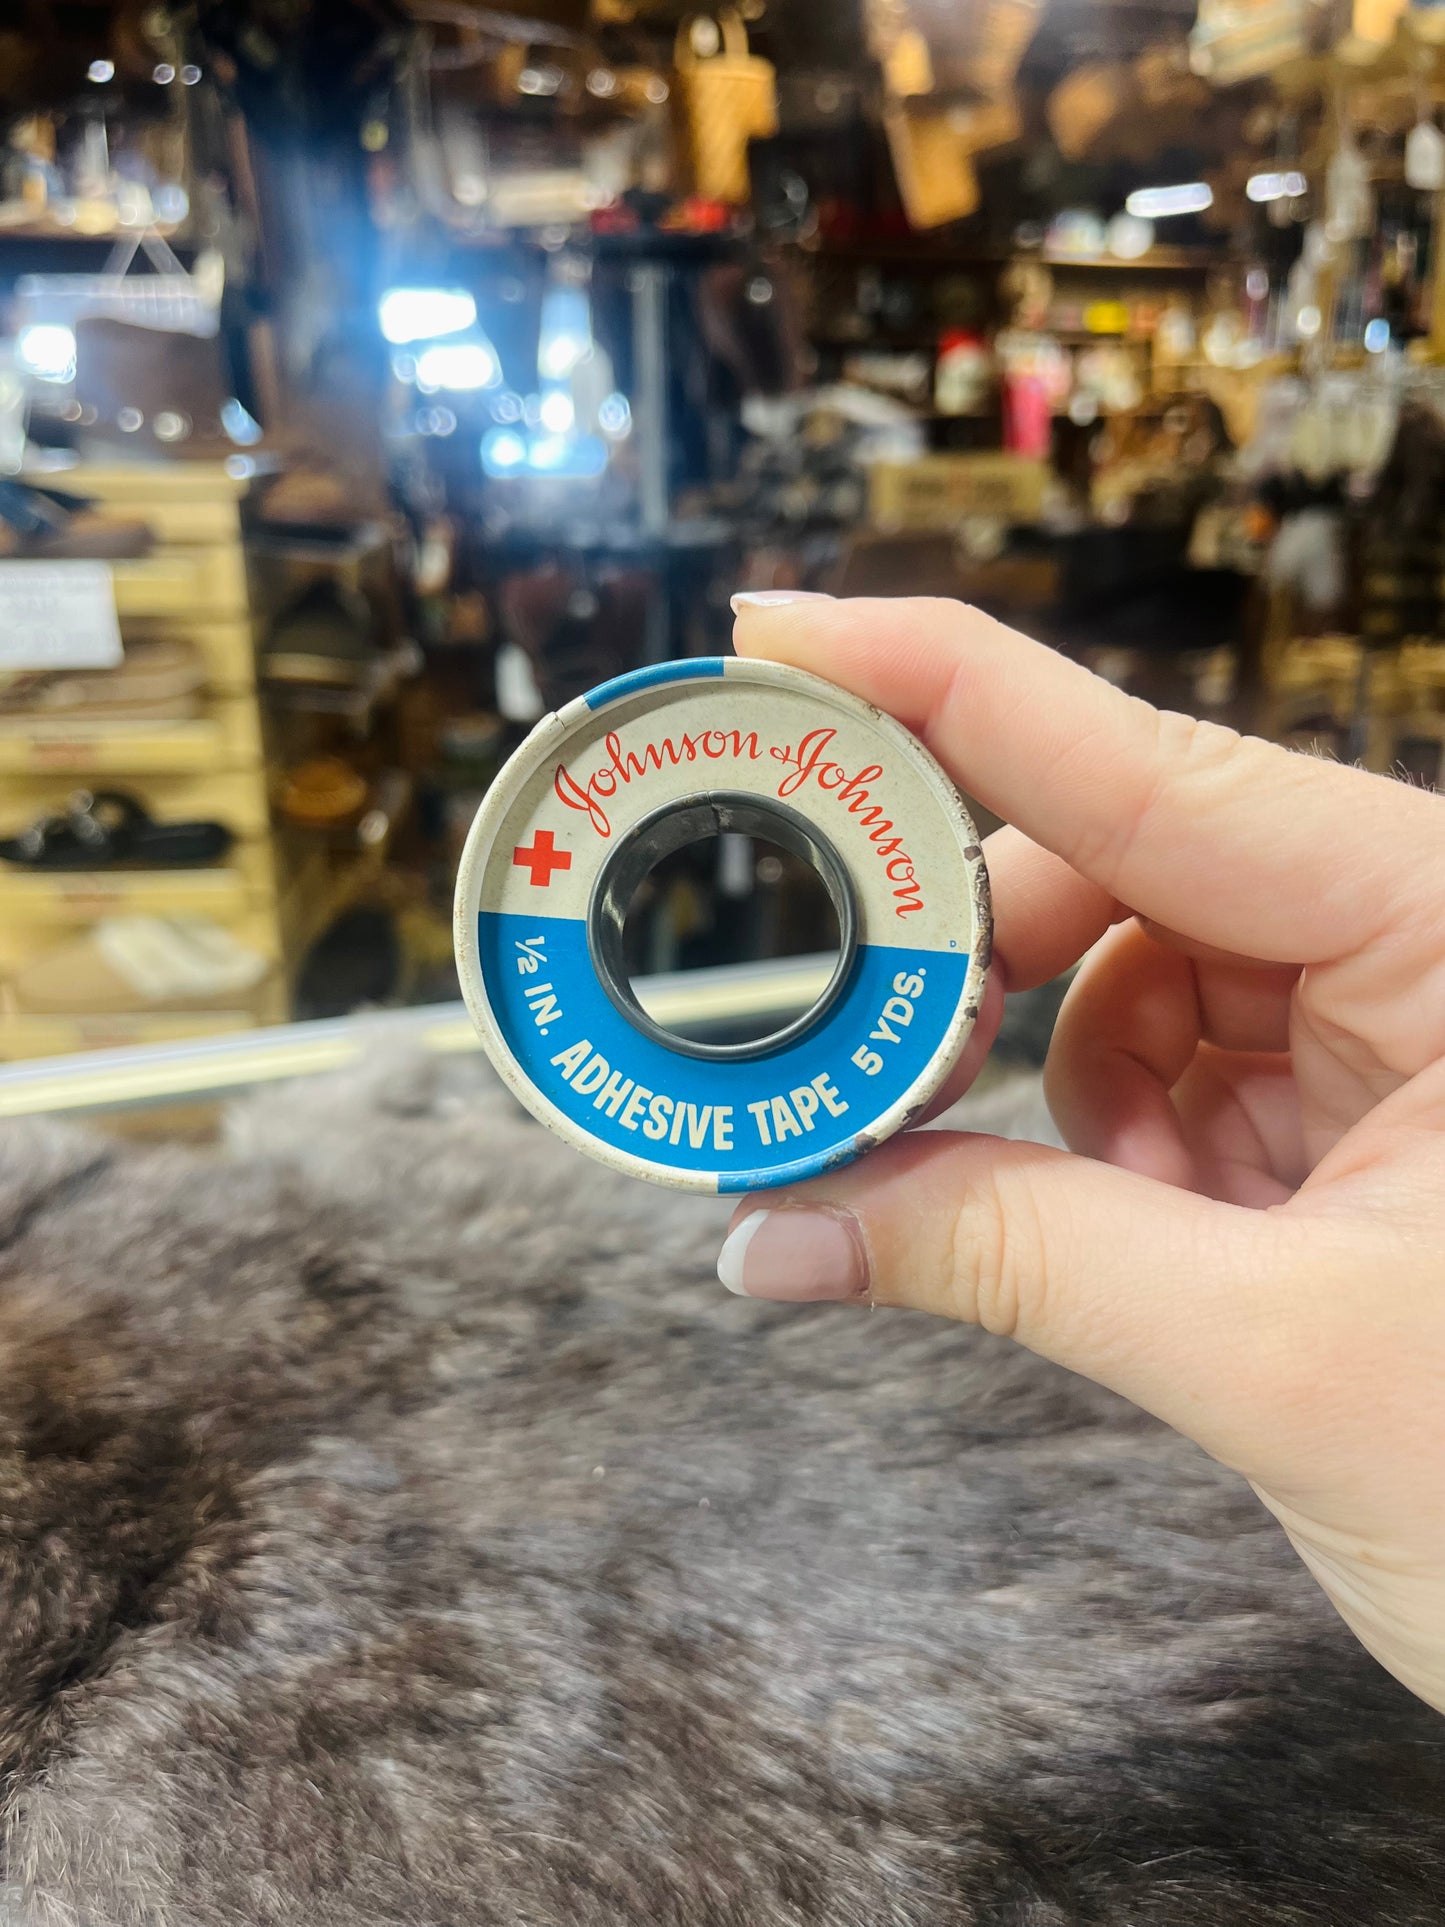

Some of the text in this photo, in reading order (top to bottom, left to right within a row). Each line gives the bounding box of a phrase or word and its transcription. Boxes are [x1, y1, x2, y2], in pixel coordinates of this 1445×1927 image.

[554, 729, 762, 838] Johnson
[778, 728, 924, 920] Johnson
[524, 980, 562, 1036] IN.
[550, 1038, 734, 1150] ADHESIVE
[747, 1072, 849, 1146] TAPE
[850, 1044, 884, 1076] 5
[870, 967, 926, 1045] YDS.
